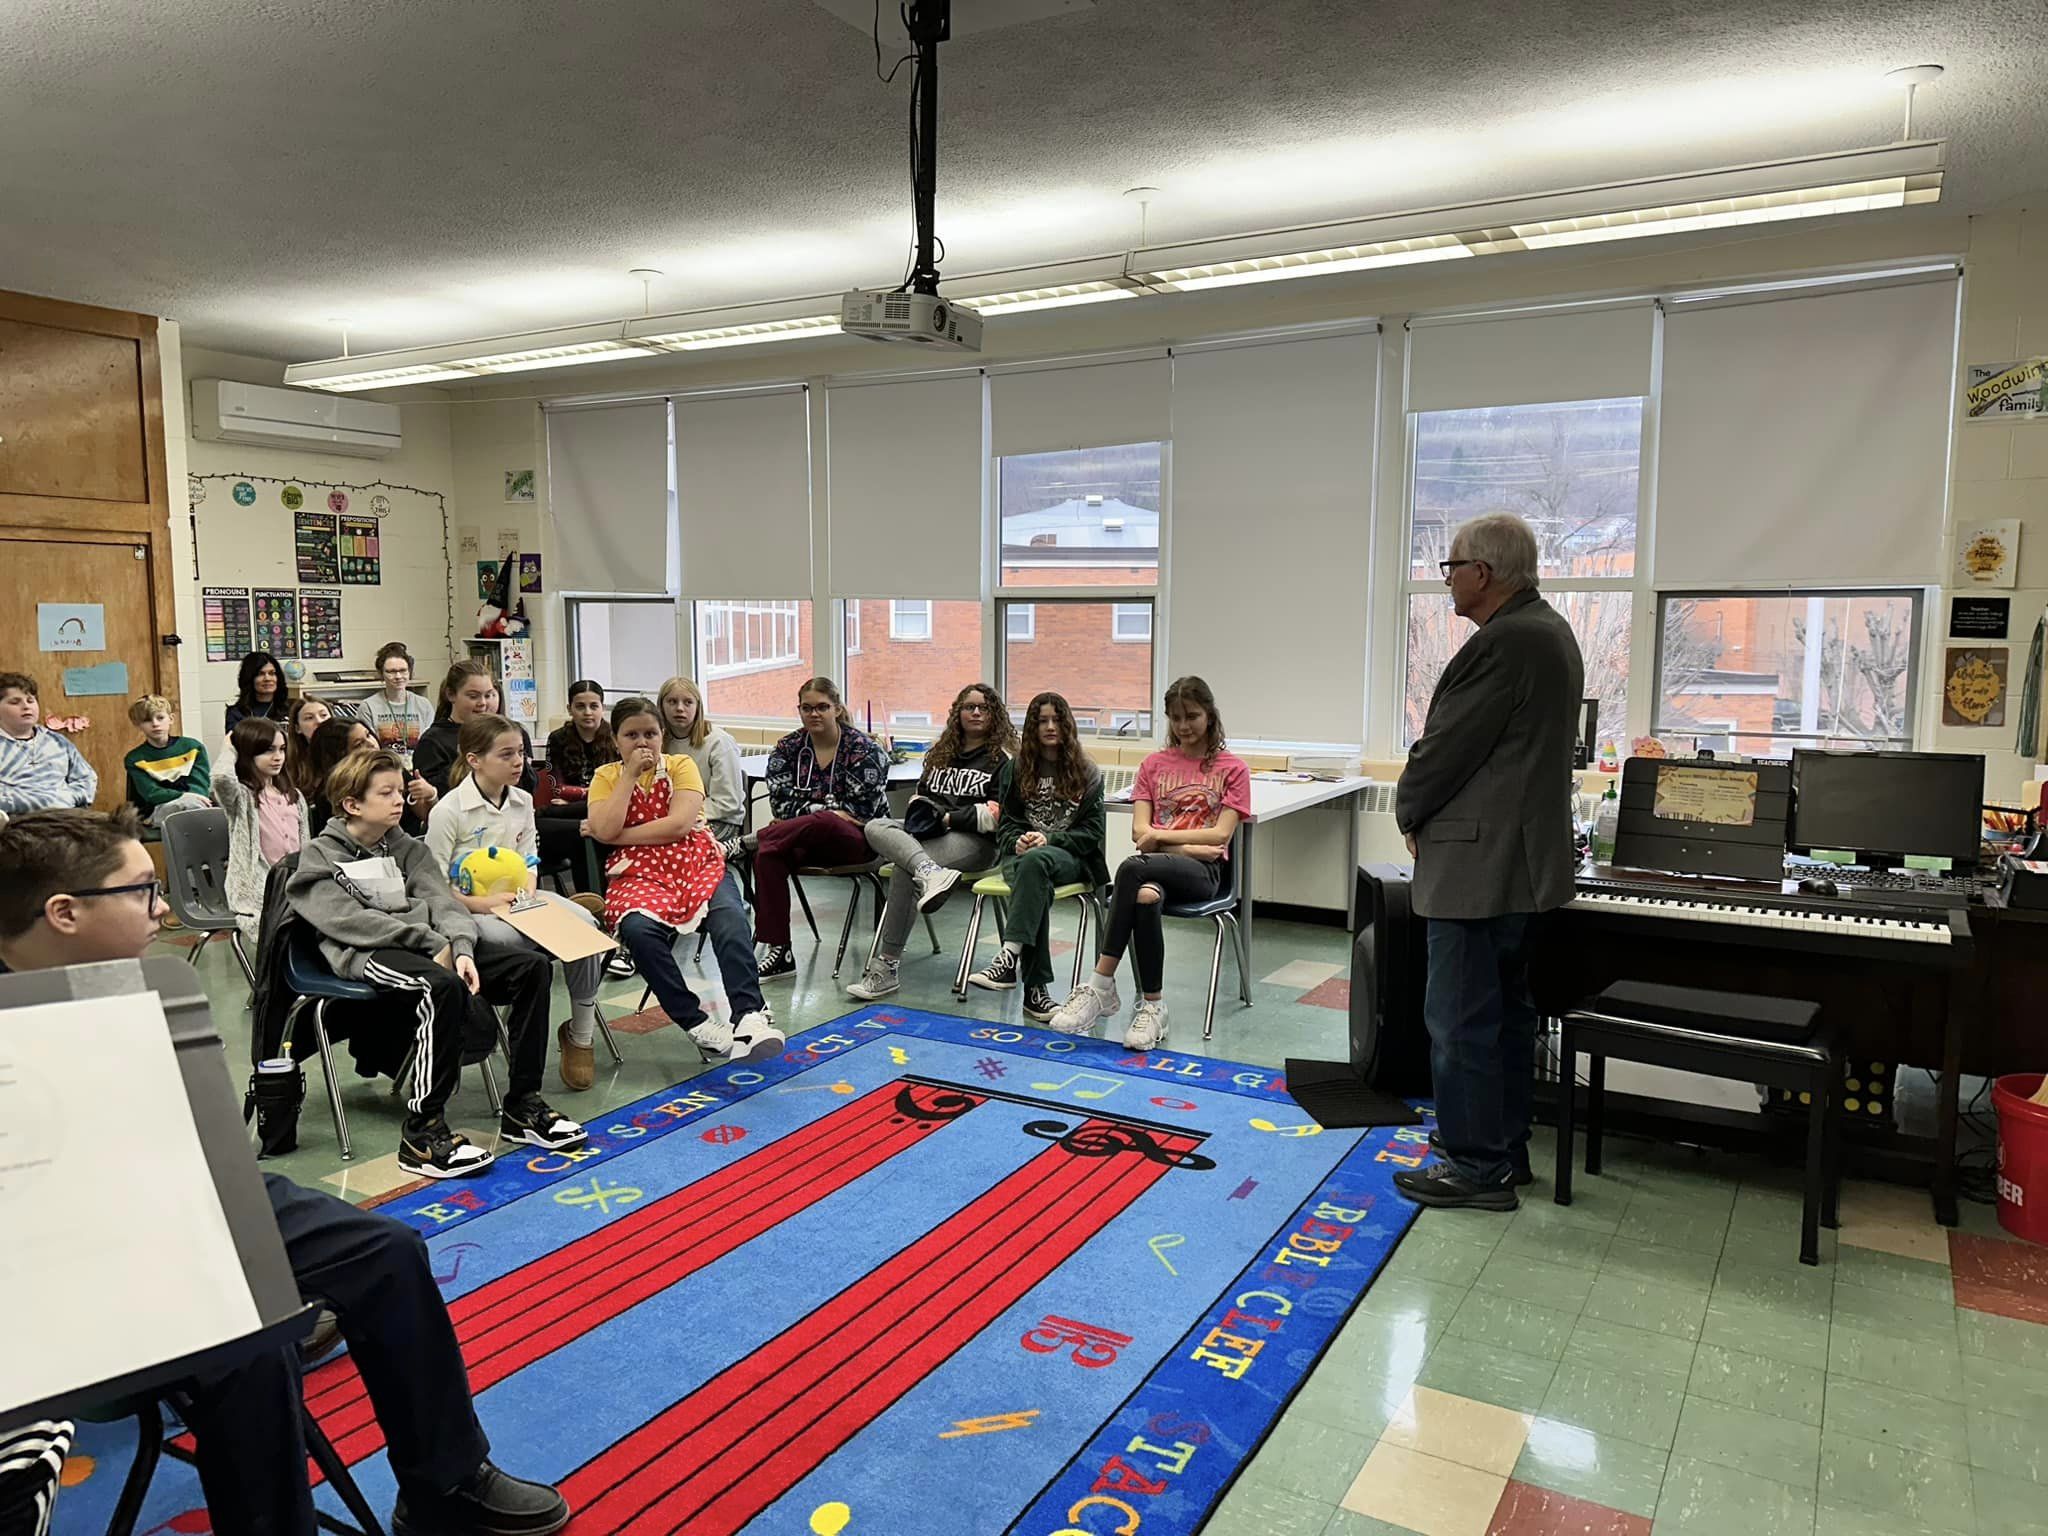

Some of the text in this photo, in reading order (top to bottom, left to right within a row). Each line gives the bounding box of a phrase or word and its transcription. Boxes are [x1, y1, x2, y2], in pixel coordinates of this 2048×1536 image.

[1967, 360, 2046, 404] Woodwin
[1974, 368, 1992, 378] The
[1998, 397, 2044, 413] family
[205, 588, 247, 596] PRONOUNS
[927, 767, 993, 798] INK
[784, 1013, 907, 1064] OCTAVE
[970, 1027, 1077, 1053] SOLO
[1190, 1190, 1377, 1381] TREBLE CLEF
